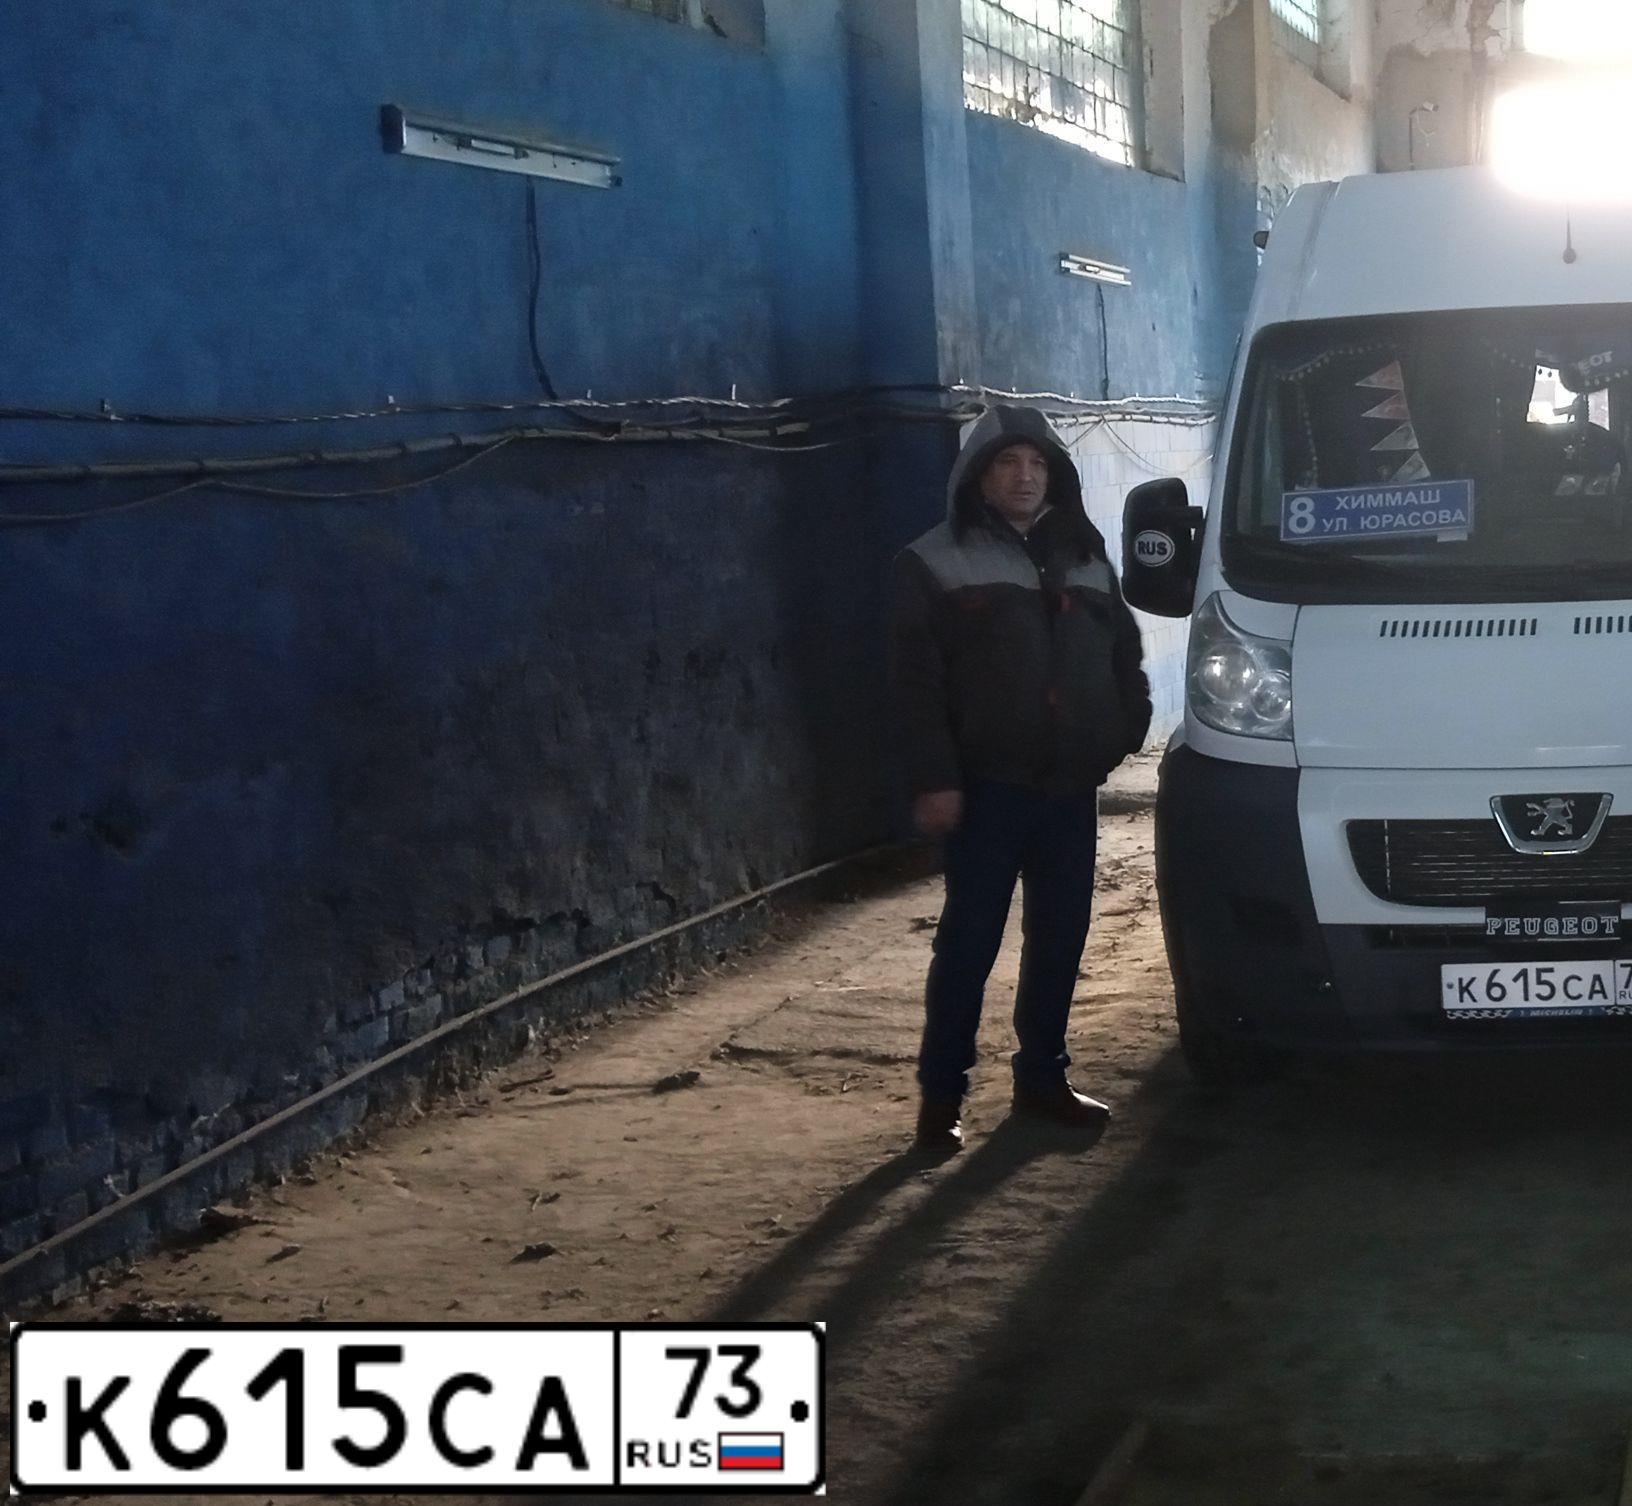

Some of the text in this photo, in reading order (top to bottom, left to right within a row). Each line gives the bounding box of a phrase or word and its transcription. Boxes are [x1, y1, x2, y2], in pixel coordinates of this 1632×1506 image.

[1335, 489, 1441, 511] ХИММАШ
[1288, 496, 1316, 534] 8
[1360, 508, 1466, 529] ЮРАСОВА
[1137, 541, 1168, 556] RUS
[1486, 916, 1619, 936] PEUGEOT
